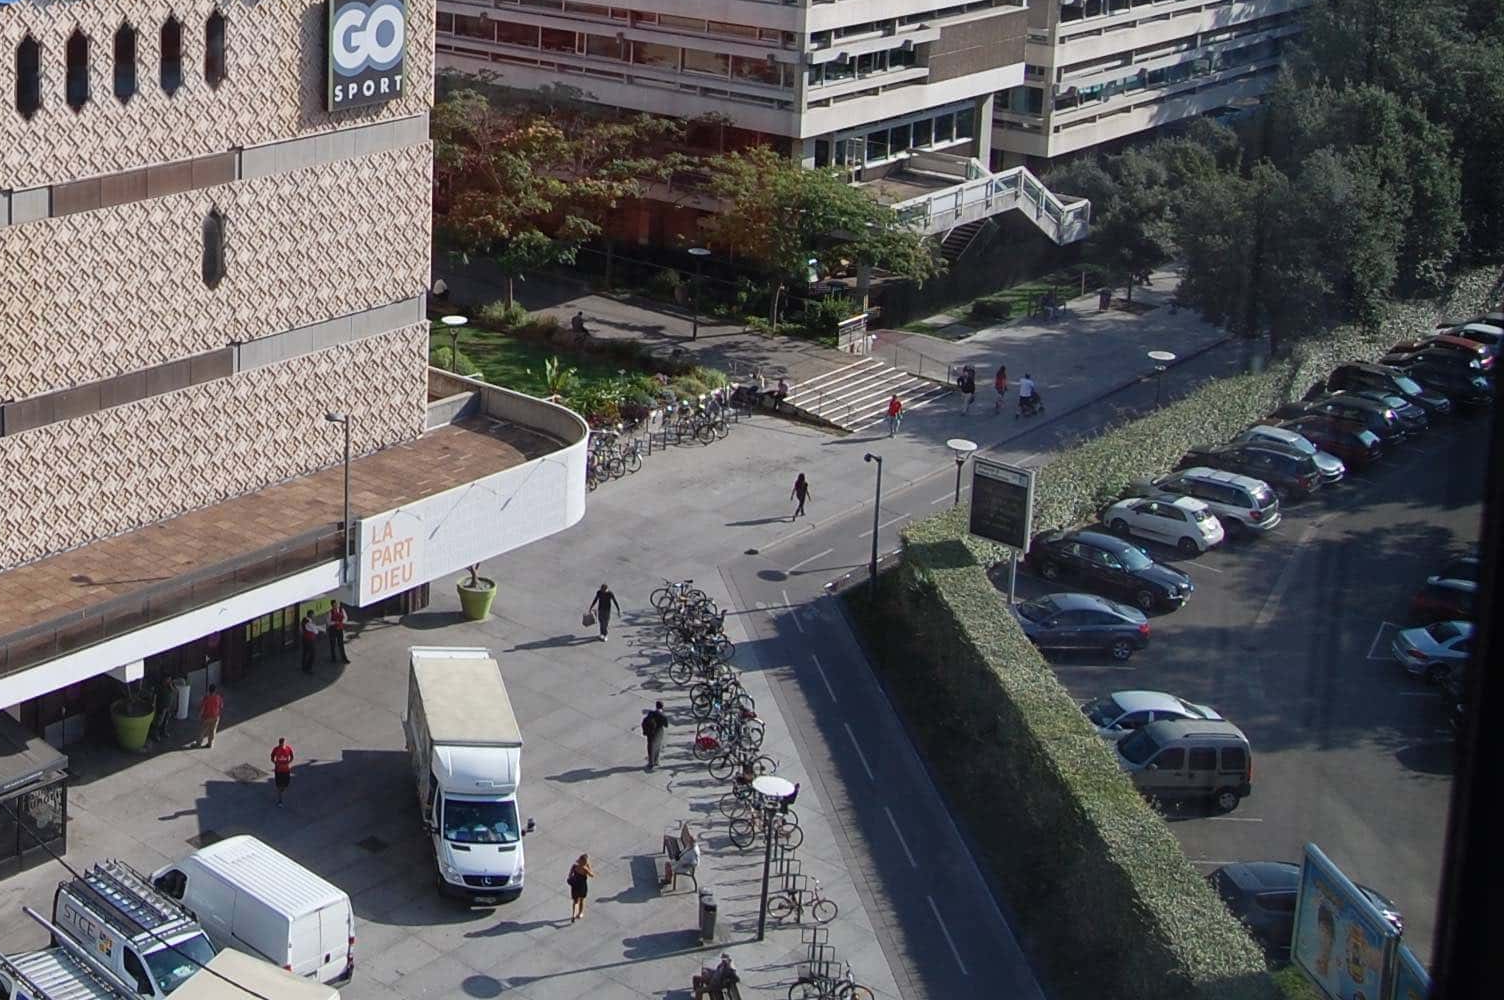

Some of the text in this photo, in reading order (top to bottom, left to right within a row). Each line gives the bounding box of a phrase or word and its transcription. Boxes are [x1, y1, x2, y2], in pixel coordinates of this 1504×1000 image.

[332, 4, 405, 69] GO
[334, 75, 403, 103] SPORT
[371, 520, 393, 545] LA
[370, 536, 415, 569] PART
[370, 561, 413, 595] DIEU
